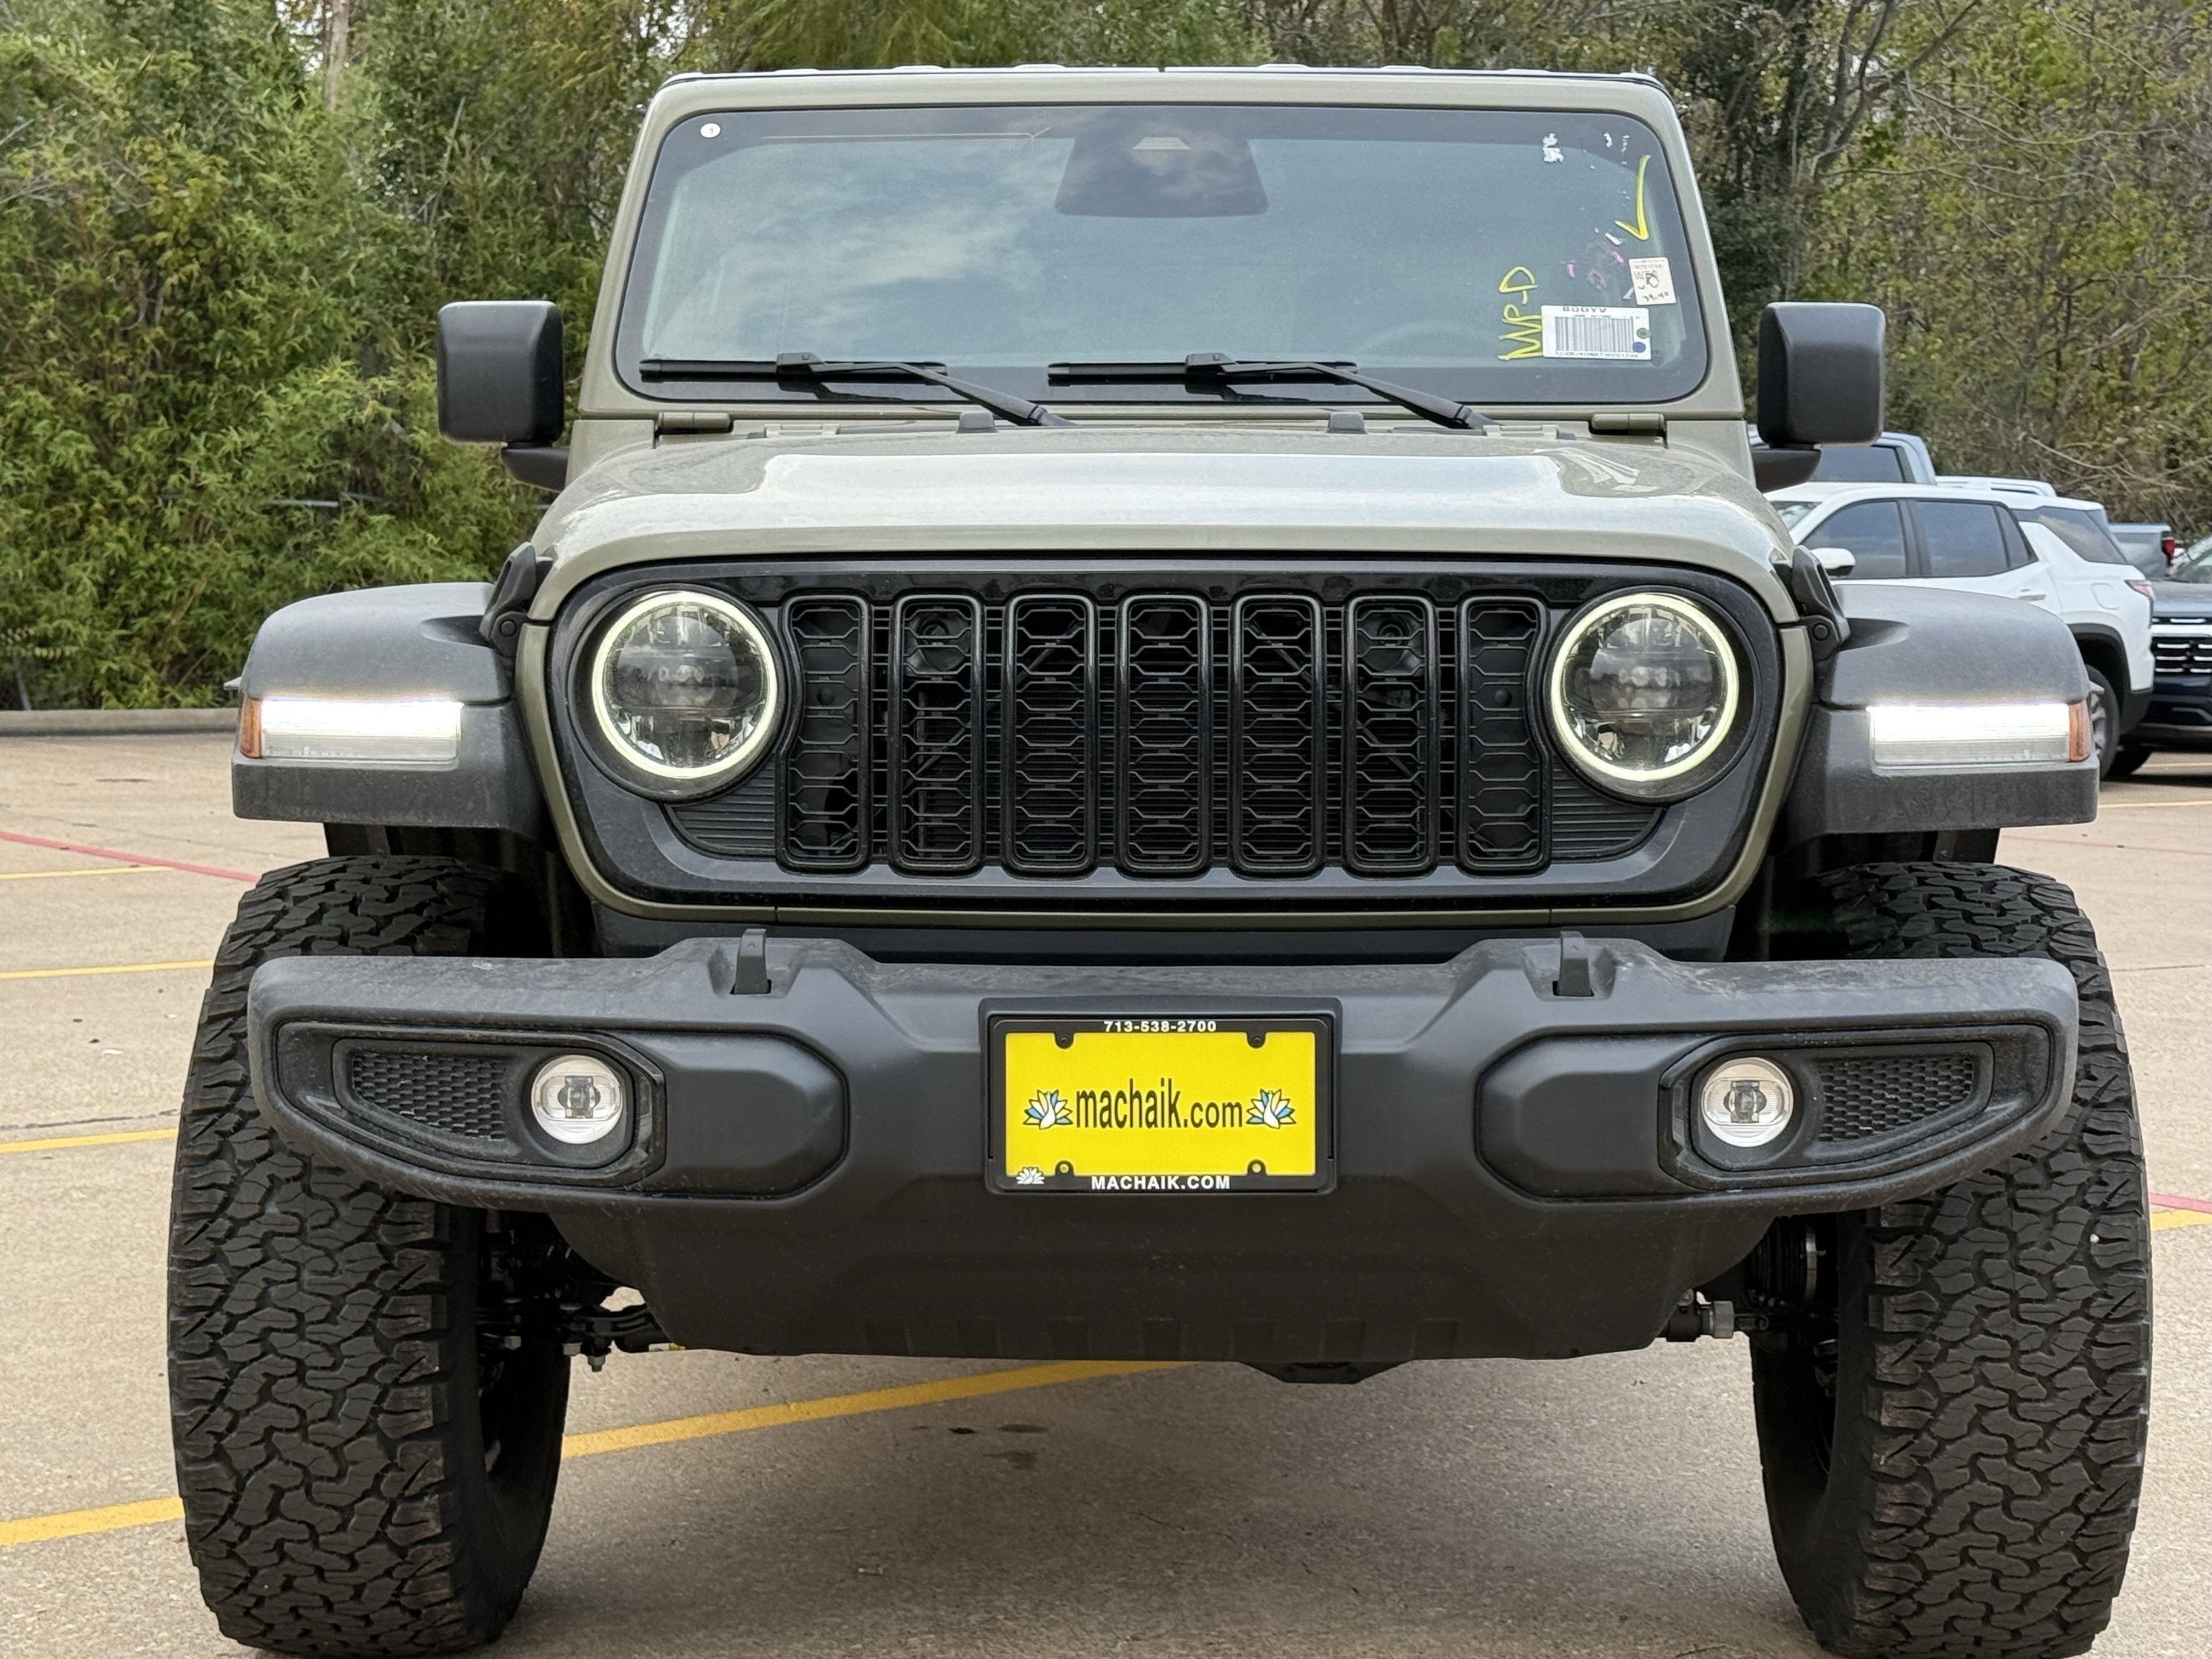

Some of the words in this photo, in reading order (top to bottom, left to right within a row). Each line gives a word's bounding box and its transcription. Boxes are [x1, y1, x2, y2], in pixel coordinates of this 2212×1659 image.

[1104, 1020, 1217, 1032] 713-538-2700
[1076, 1078, 1242, 1128] machaik.com
[1091, 1176, 1230, 1189] MACHAIK.COM
